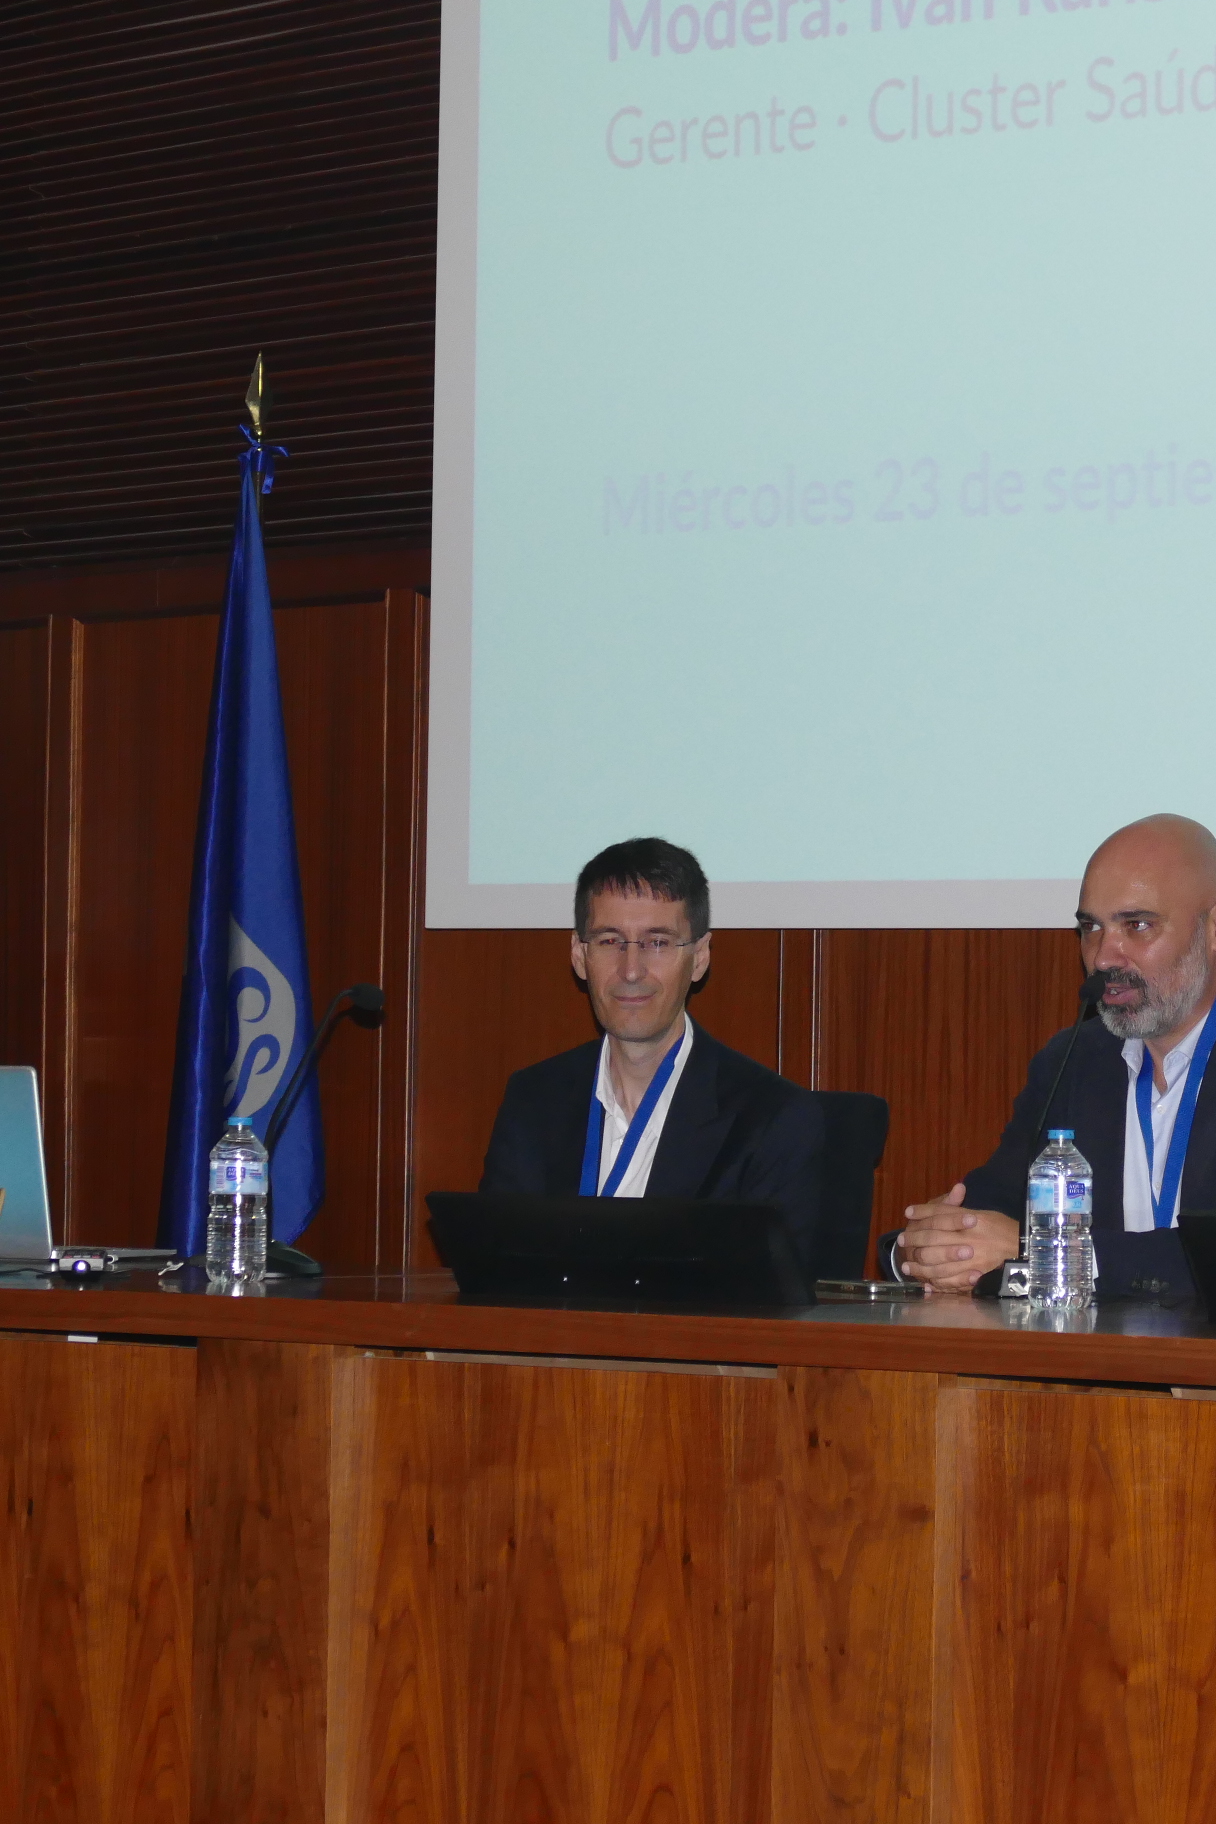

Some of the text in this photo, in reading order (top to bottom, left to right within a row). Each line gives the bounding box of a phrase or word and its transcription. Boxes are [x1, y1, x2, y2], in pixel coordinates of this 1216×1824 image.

[608, 0, 848, 62] Modera:
[605, 95, 817, 169] Gerente
[868, 74, 1067, 143] Cluster
[601, 462, 856, 537] Miércoles
[873, 456, 940, 523] 23
[960, 450, 1025, 516] de
